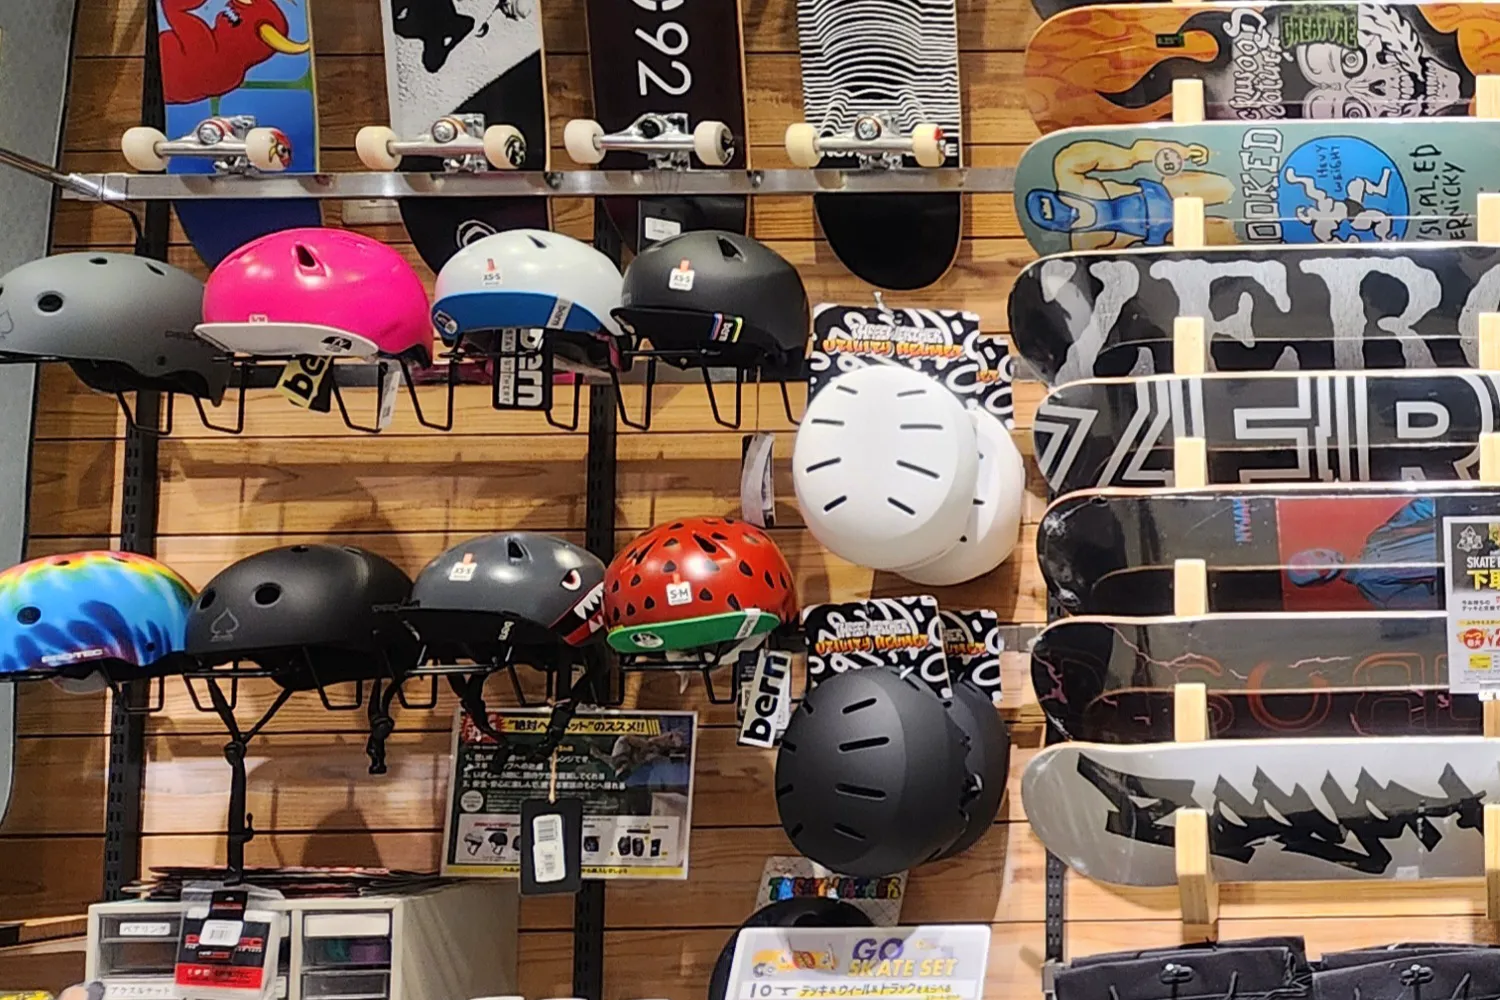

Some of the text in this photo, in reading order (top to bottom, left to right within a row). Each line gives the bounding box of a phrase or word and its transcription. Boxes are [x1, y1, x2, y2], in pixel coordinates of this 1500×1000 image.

[634, 0, 692, 96] 92
[1466, 556, 1496, 568] SKATE
[744, 654, 790, 743] bern
[852, 937, 905, 961] GO
[848, 958, 958, 977] SKATE SET
